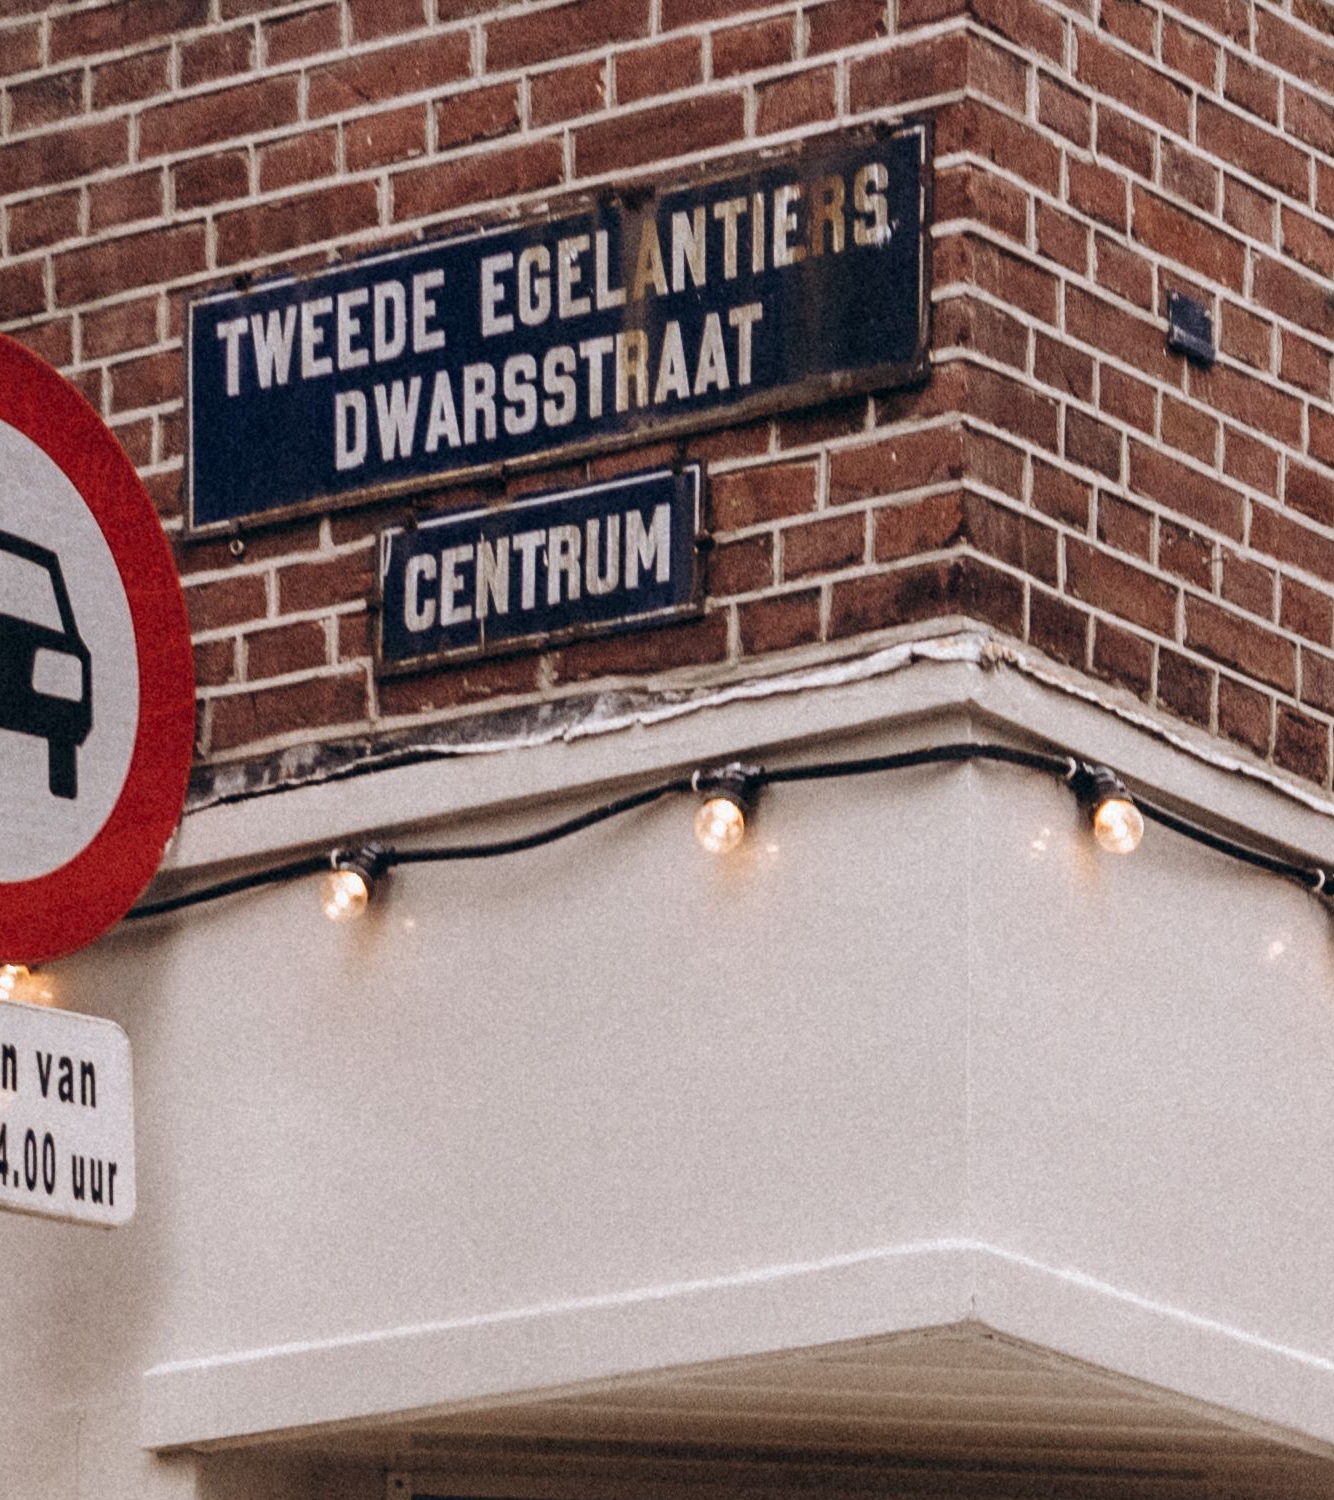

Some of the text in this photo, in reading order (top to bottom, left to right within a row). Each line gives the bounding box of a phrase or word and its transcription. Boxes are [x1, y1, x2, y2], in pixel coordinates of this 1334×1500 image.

[217, 163, 893, 396] TWEEDE EGELANTIERS
[334, 304, 763, 472] DWARSSTRAAT
[404, 504, 671, 634] CENTRUM
[36, 1050, 97, 1107] van
[72, 1154, 118, 1206] uur
